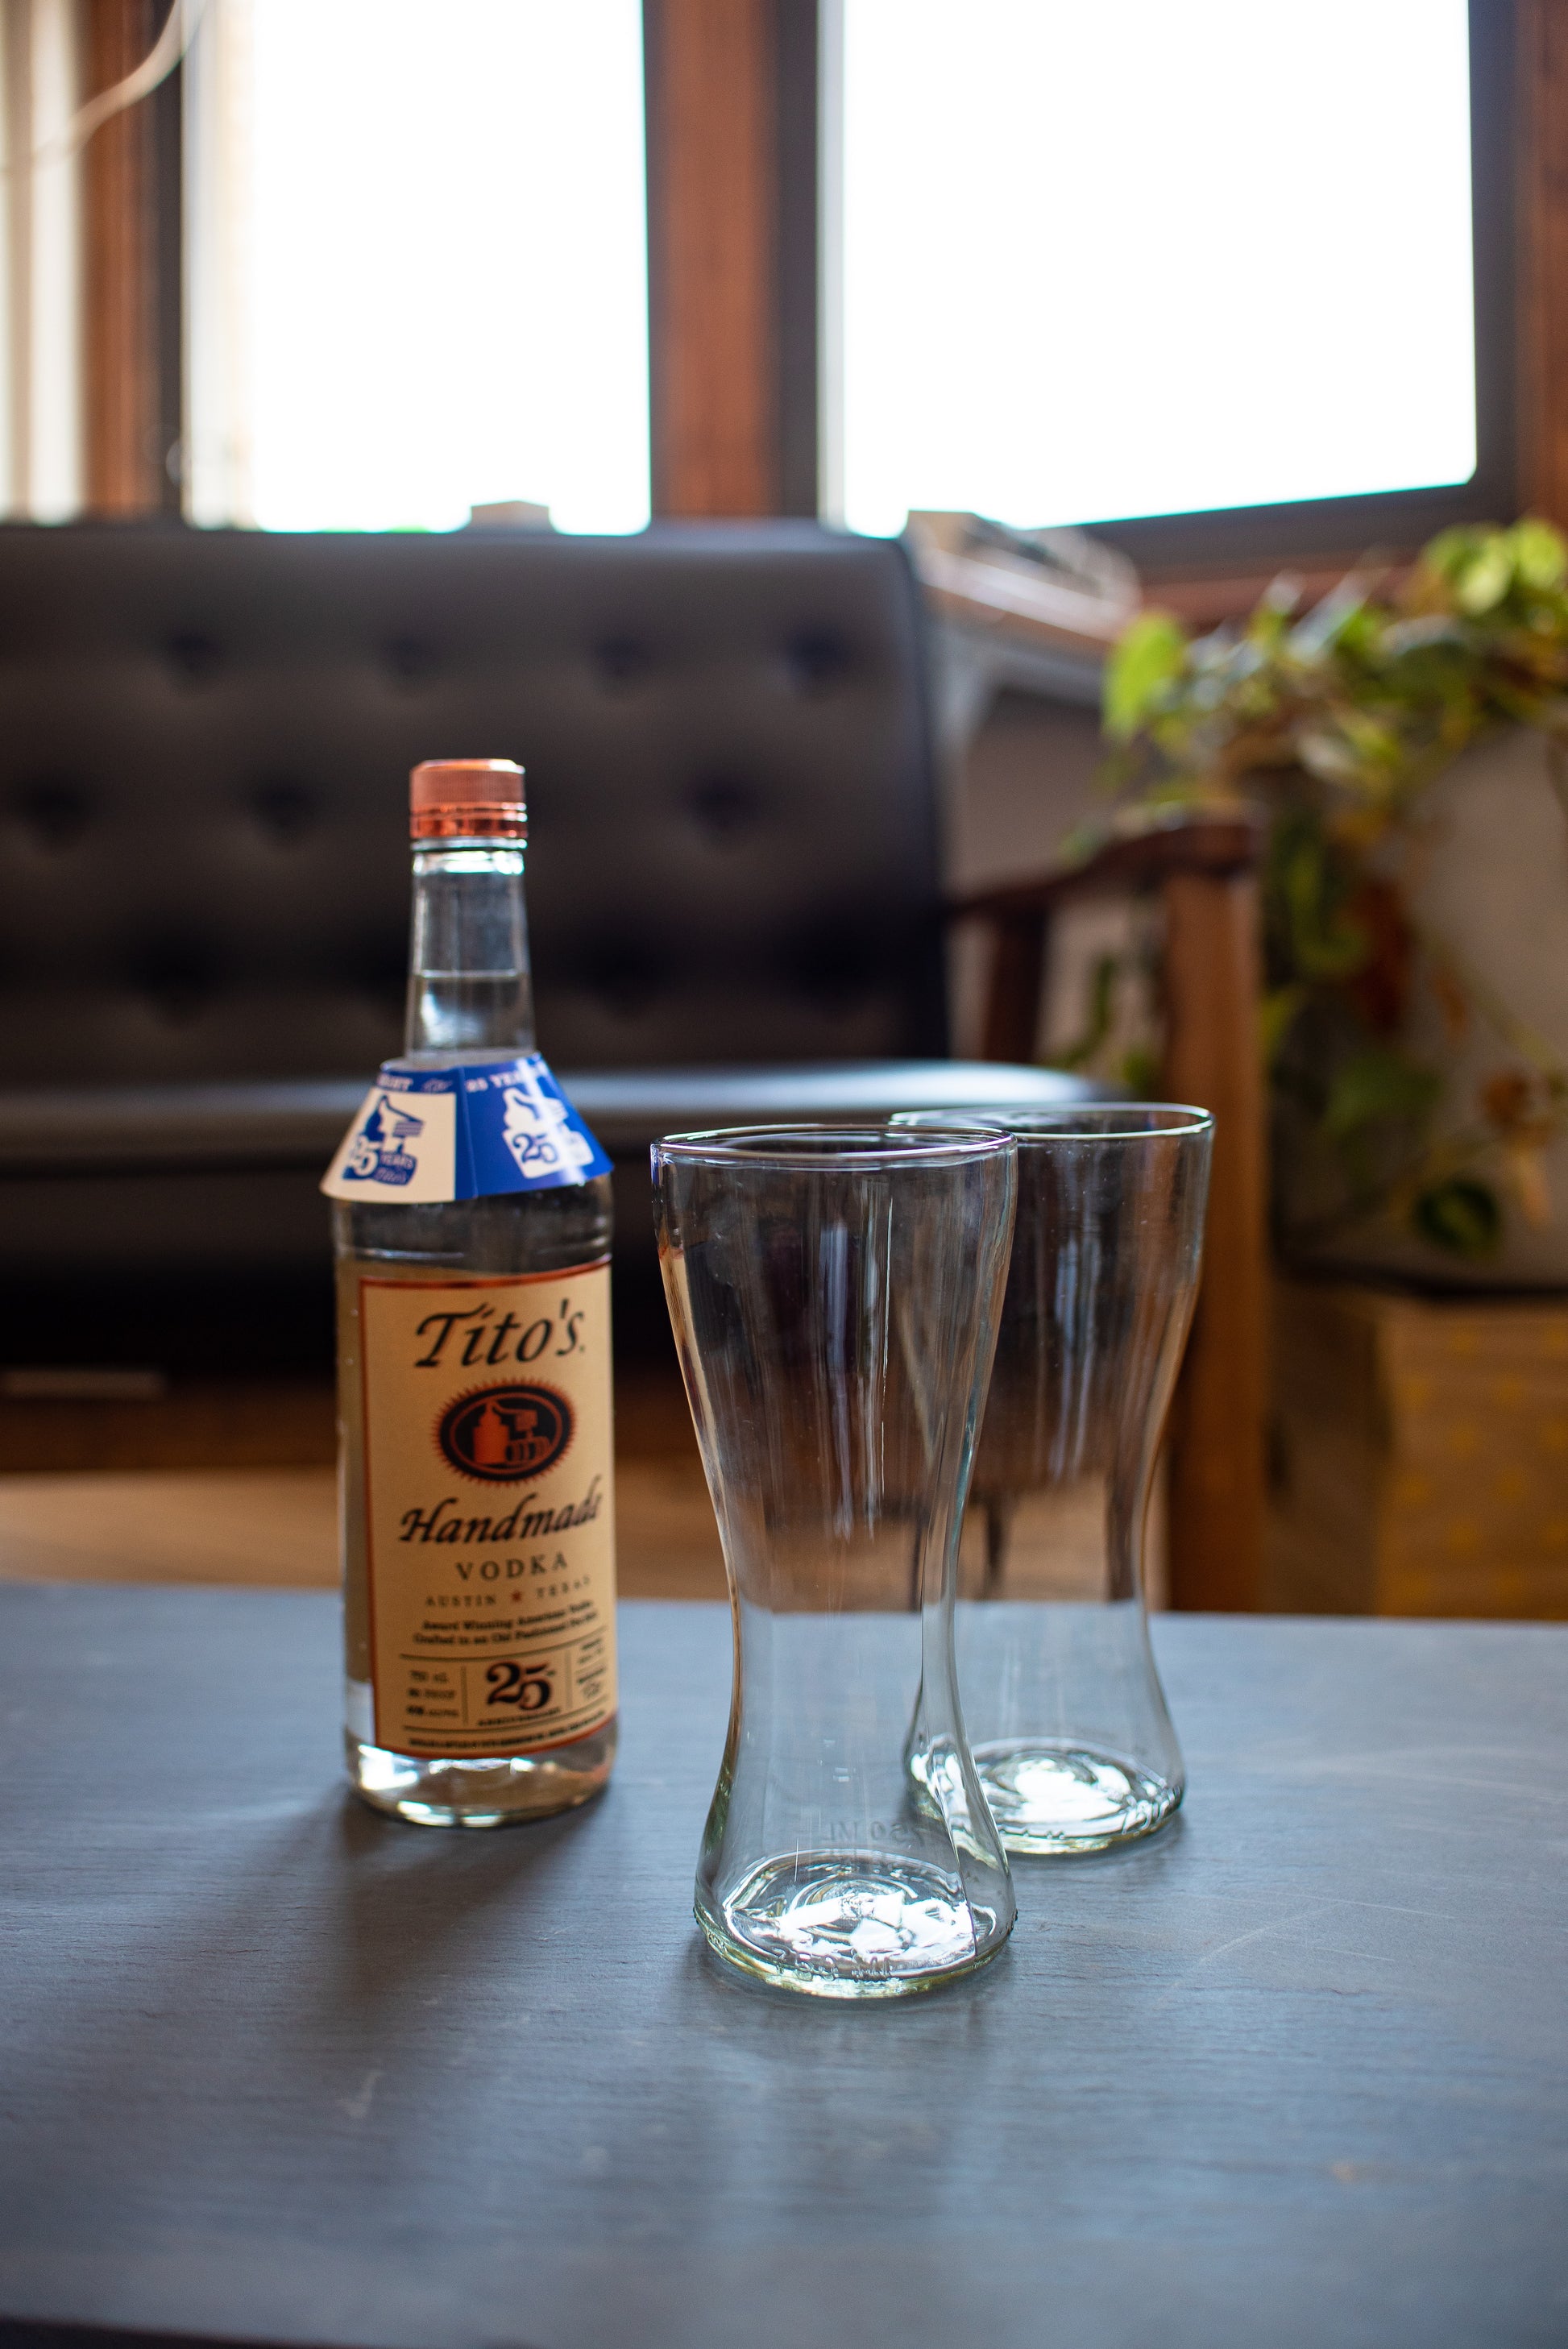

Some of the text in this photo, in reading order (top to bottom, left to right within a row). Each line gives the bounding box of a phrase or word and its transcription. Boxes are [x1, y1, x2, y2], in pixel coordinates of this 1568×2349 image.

[512, 1131, 559, 1167] 25
[413, 1297, 585, 1368] Tito's
[399, 1475, 602, 1544] Handmade
[455, 1552, 568, 1582] VODKA
[425, 1594, 497, 1608] AUSTIN
[486, 1660, 552, 1712] 25
